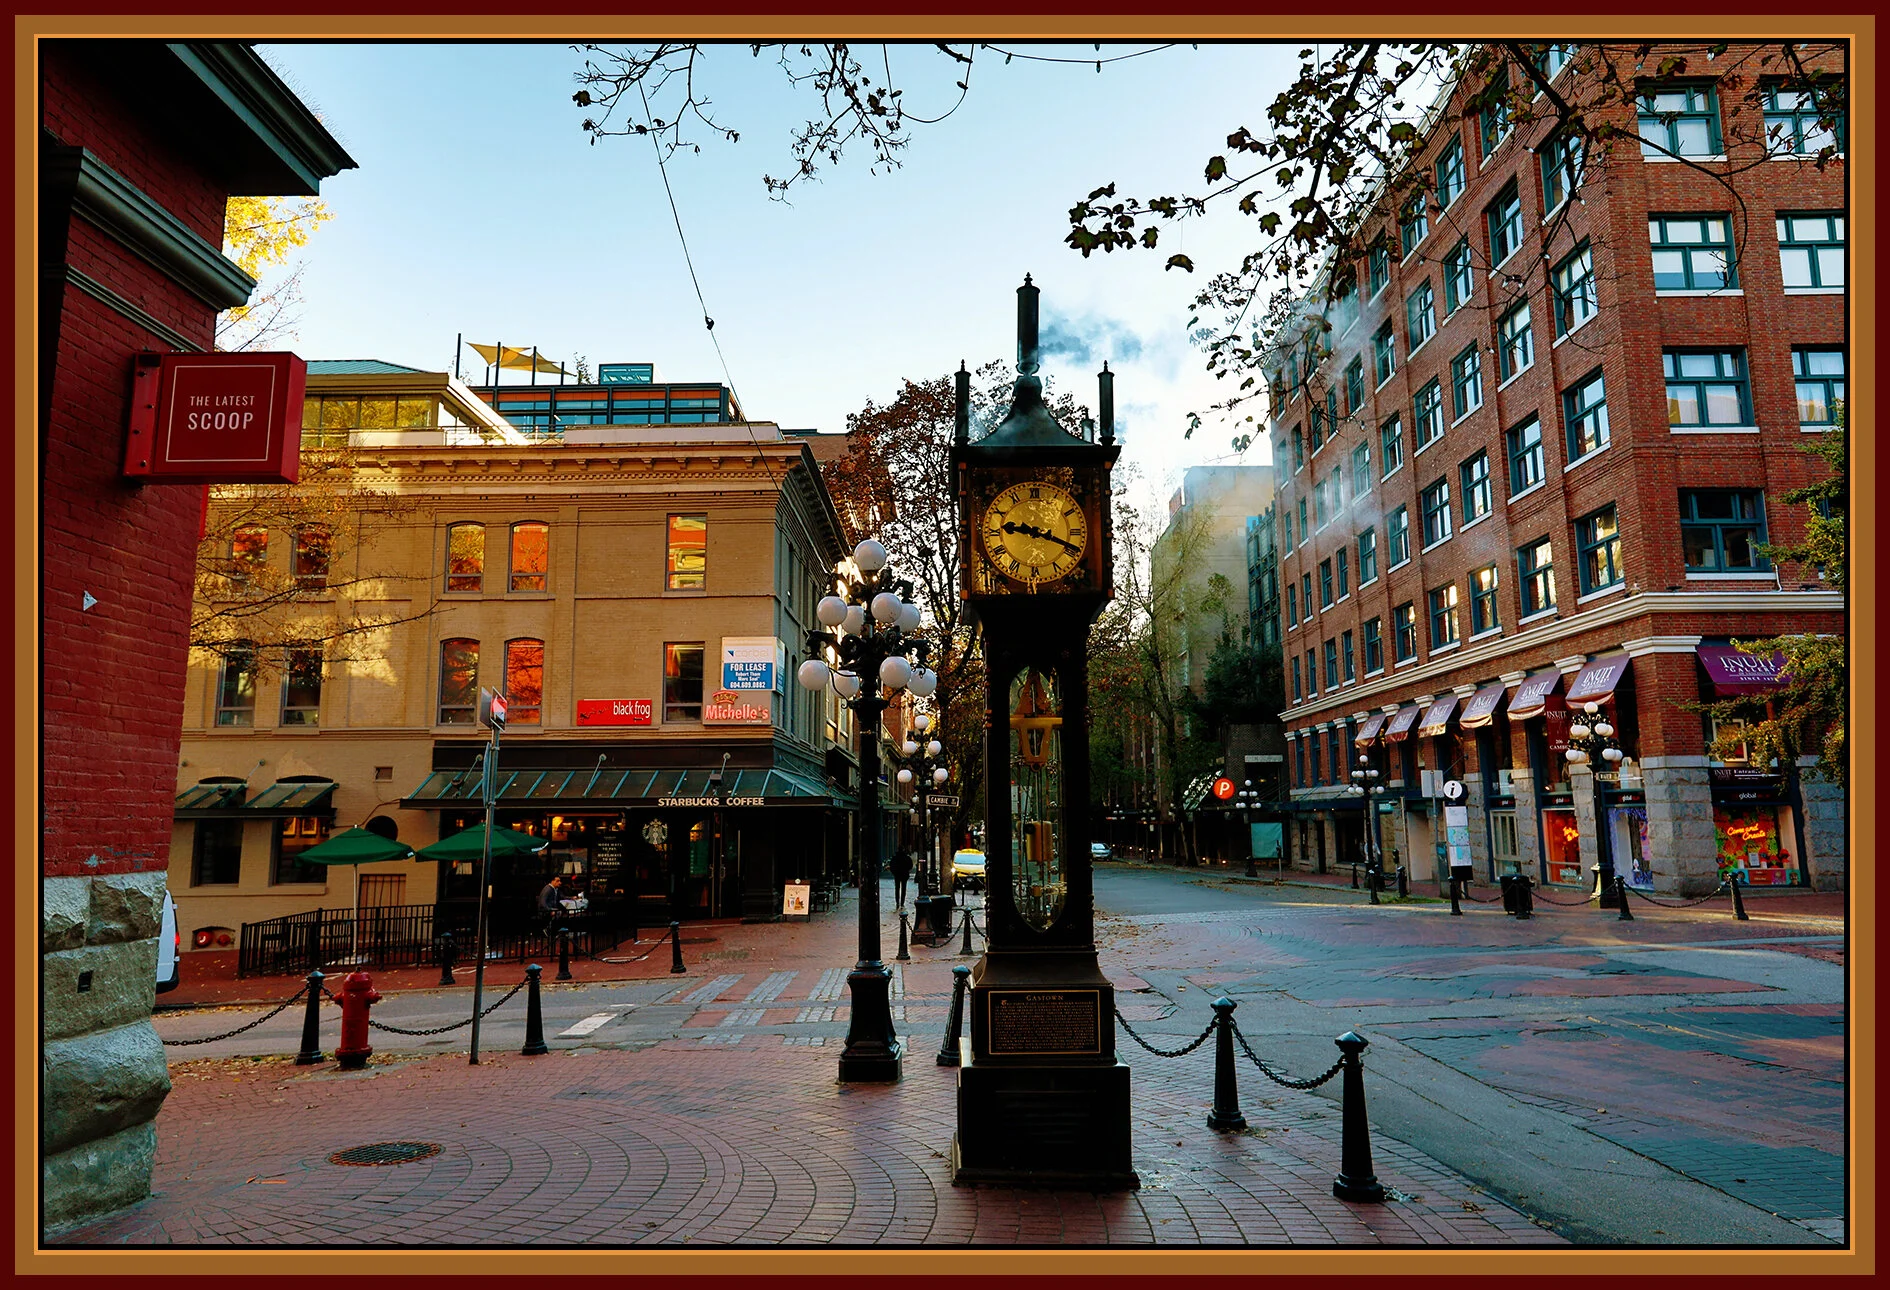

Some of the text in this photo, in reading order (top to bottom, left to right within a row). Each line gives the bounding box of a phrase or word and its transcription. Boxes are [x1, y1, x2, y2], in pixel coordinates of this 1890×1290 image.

[190, 396, 255, 406] THE LATEST
[187, 412, 253, 430] SCOOP
[1720, 655, 1776, 668] INUIT
[730, 663, 767, 672] FOR LEASE
[1582, 665, 1616, 684] INUIT
[613, 700, 651, 719] black frog
[704, 703, 769, 720] Michelle's
[1546, 710, 1568, 719] INUIT
[1219, 781, 1231, 796] P
[930, 796, 949, 805] CAMBIE
[1739, 792, 1757, 800] global
[658, 797, 765, 807] STARBUCKS COFFEE
[1742, 829, 1766, 840] Create
